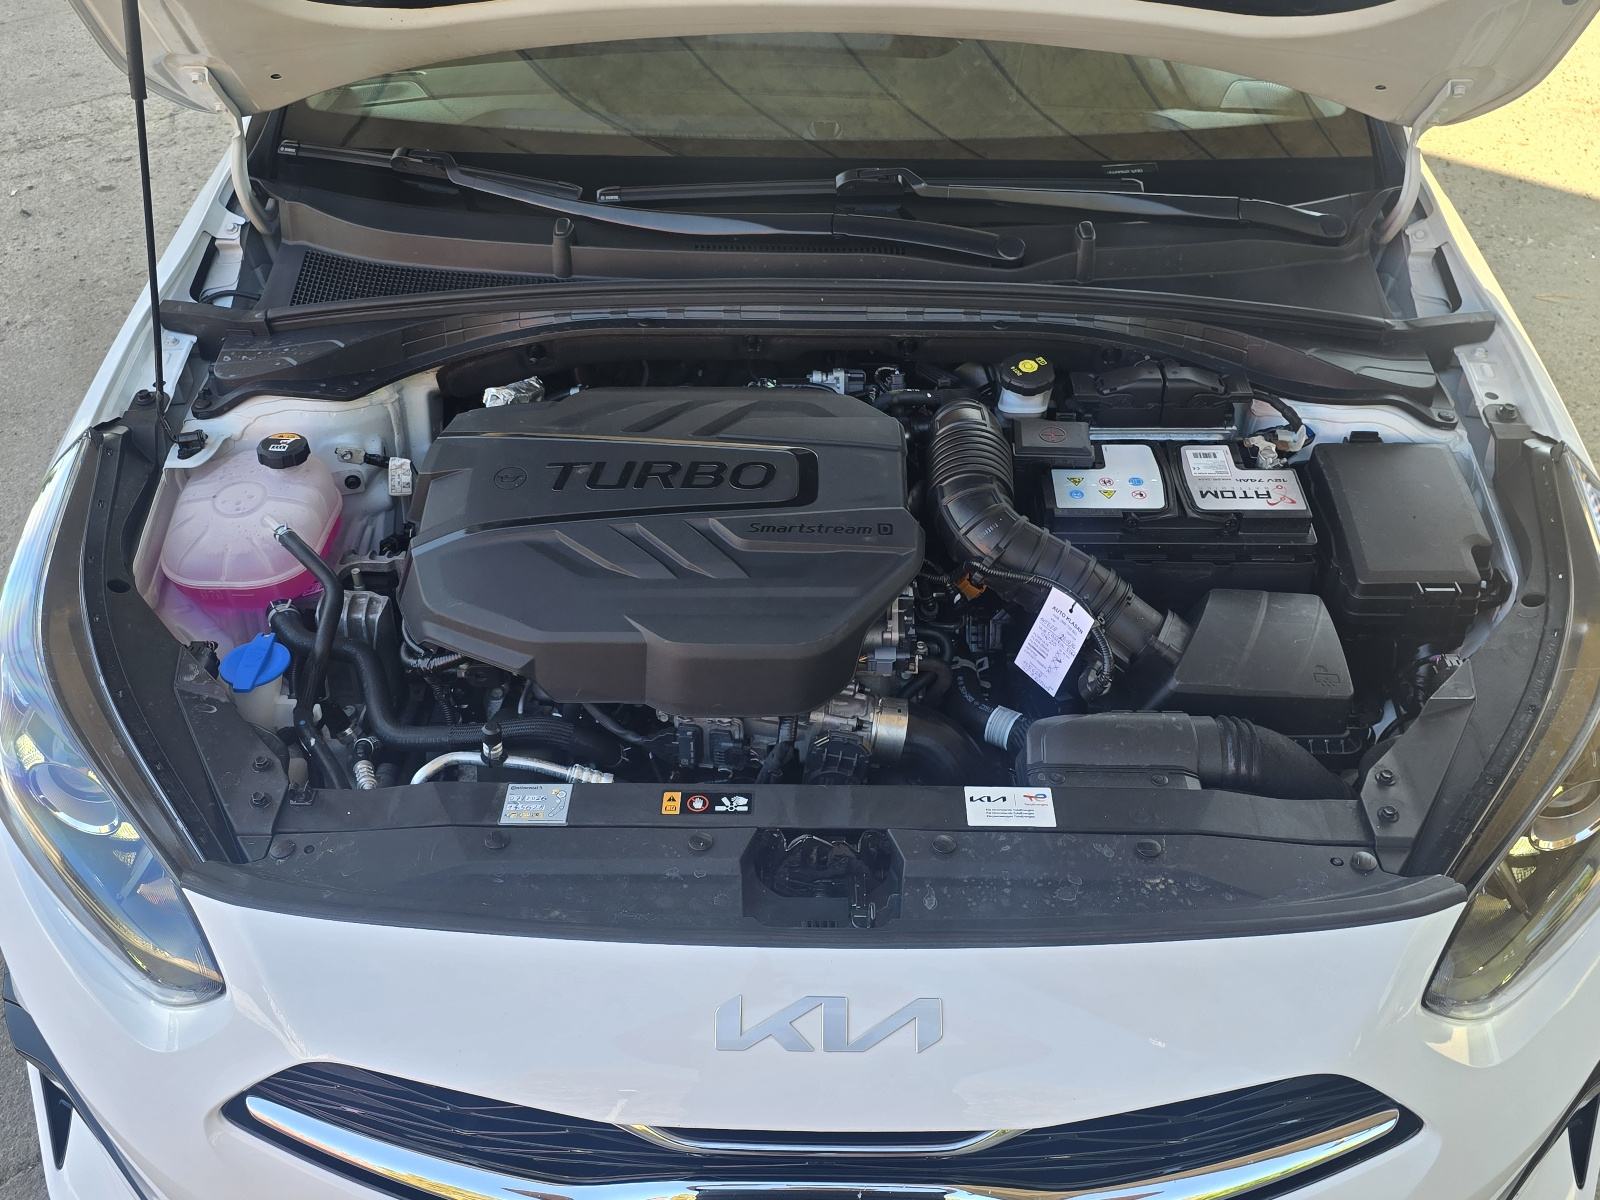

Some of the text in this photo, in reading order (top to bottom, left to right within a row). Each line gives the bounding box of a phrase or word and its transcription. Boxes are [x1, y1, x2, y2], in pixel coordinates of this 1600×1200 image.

[545, 461, 777, 491] TURBO
[1200, 490, 1272, 499] ATOM
[748, 522, 872, 534] Smartstream
[1051, 606, 1066, 618] AUTO
[970, 795, 1006, 803] KIA
[714, 994, 943, 1054] KIA
